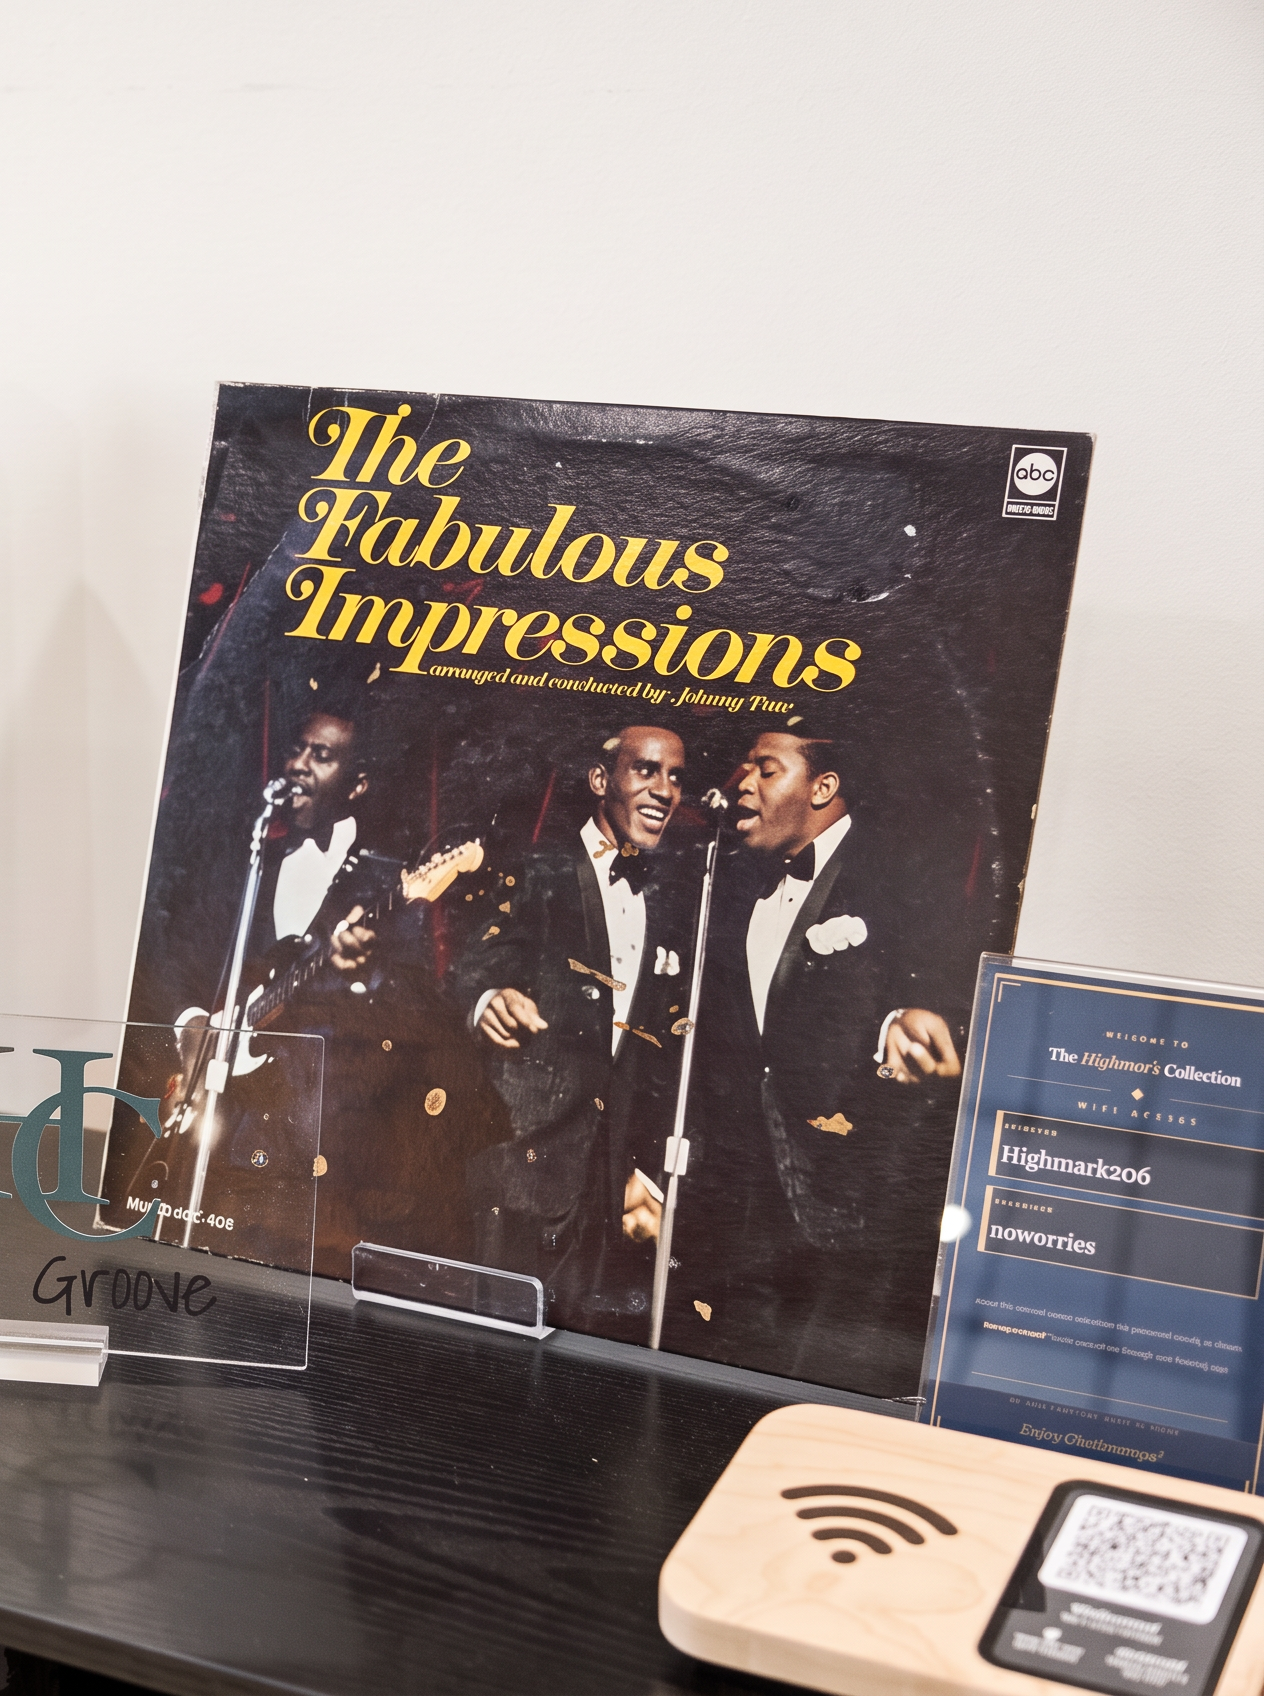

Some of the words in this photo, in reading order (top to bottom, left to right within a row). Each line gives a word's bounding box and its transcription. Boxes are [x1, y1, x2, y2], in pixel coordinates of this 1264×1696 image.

[308, 403, 471, 489] The
[1016, 463, 1055, 482] abc
[296, 485, 730, 594] Fabulous
[284, 563, 863, 693] Impressions
[429, 664, 511, 685] arranged
[510, 671, 549, 687] and
[1049, 1047, 1078, 1064] The
[1163, 1063, 1242, 1088] Collection
[1000, 1144, 1152, 1186] Highmark206
[989, 1223, 1097, 1255] noworries
[32, 1255, 218, 1316] Groove
